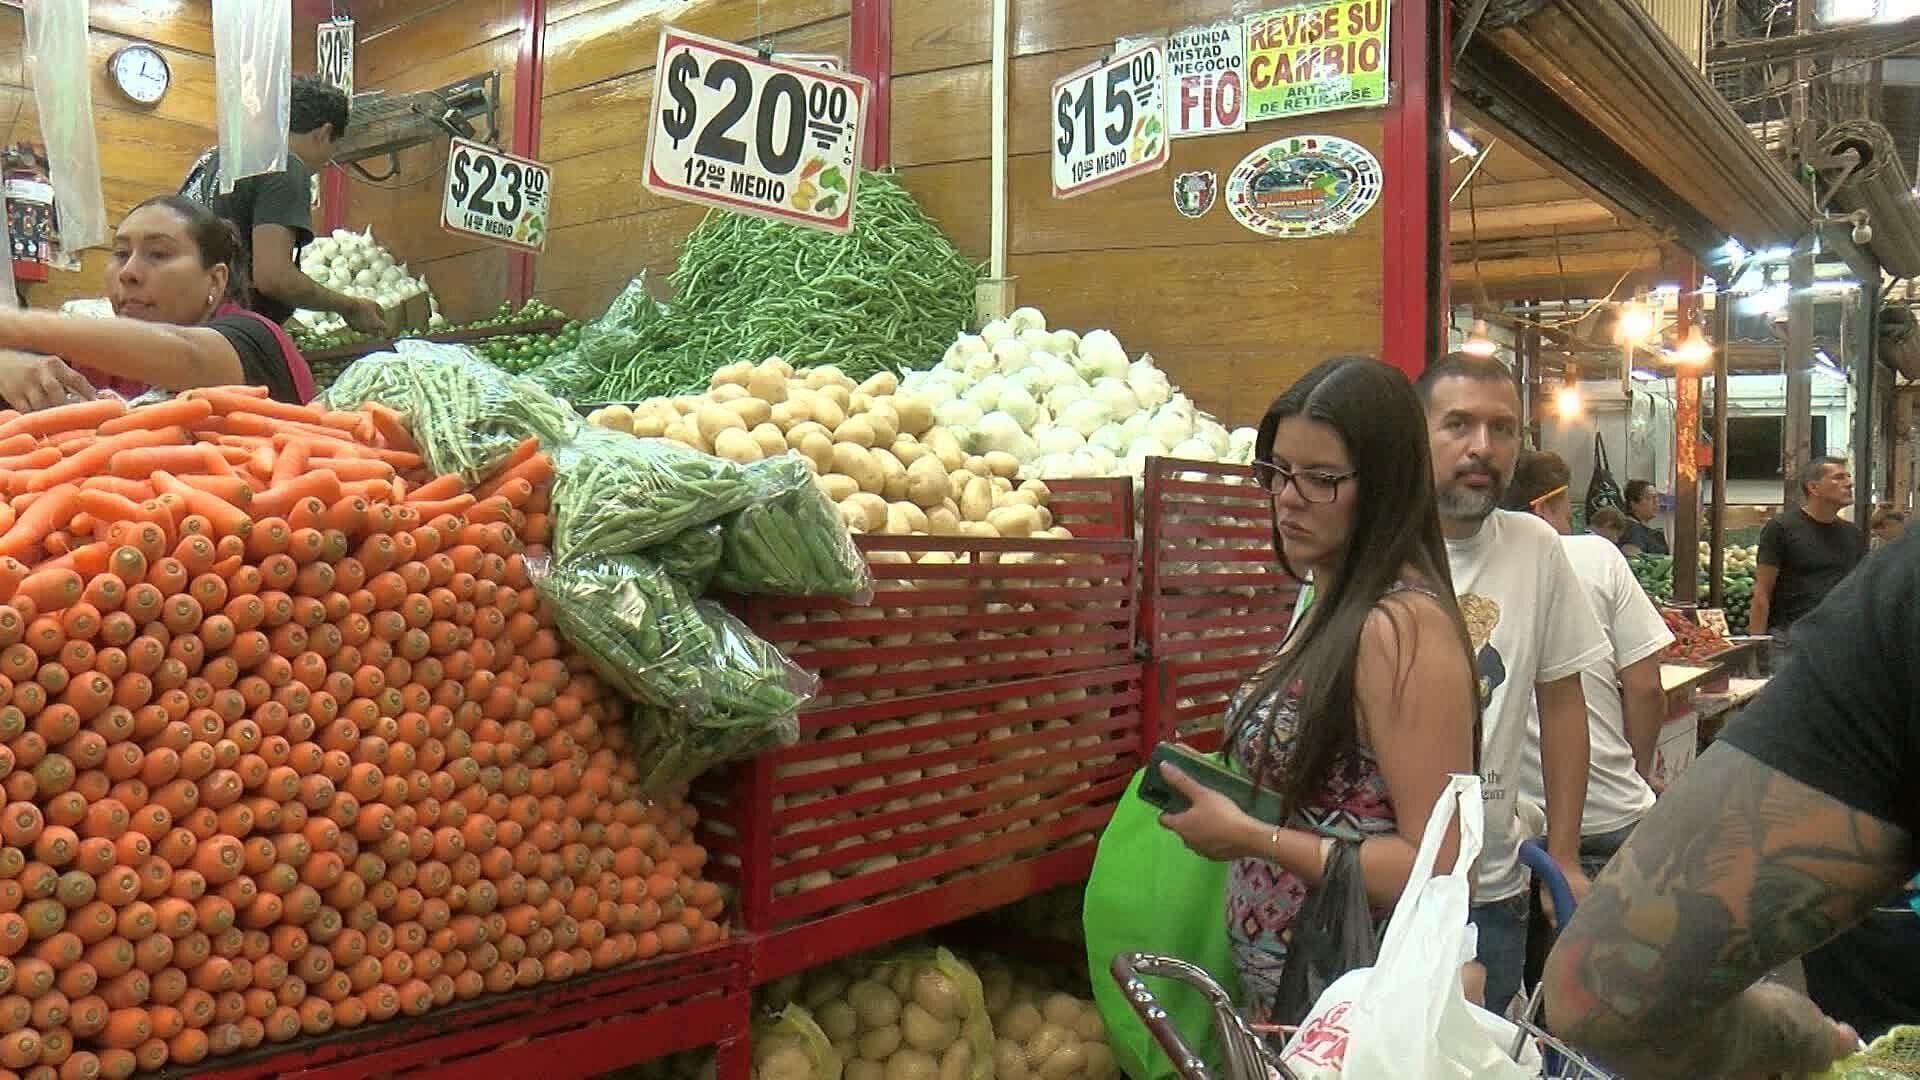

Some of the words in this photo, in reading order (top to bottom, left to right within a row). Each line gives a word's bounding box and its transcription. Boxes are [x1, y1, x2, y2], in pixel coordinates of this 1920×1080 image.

[1250, 7, 1340, 51] REVISE
[1347, 0, 1383, 36] SU
[1174, 55, 1241, 76] NEGOCIO
[1249, 37, 1382, 90] CAMBIO
[1260, 101, 1280, 114] DE
[1096, 147, 1127, 174] MEDIO
[729, 171, 785, 204] MEDIO
[484, 219, 514, 238] MEDIO
